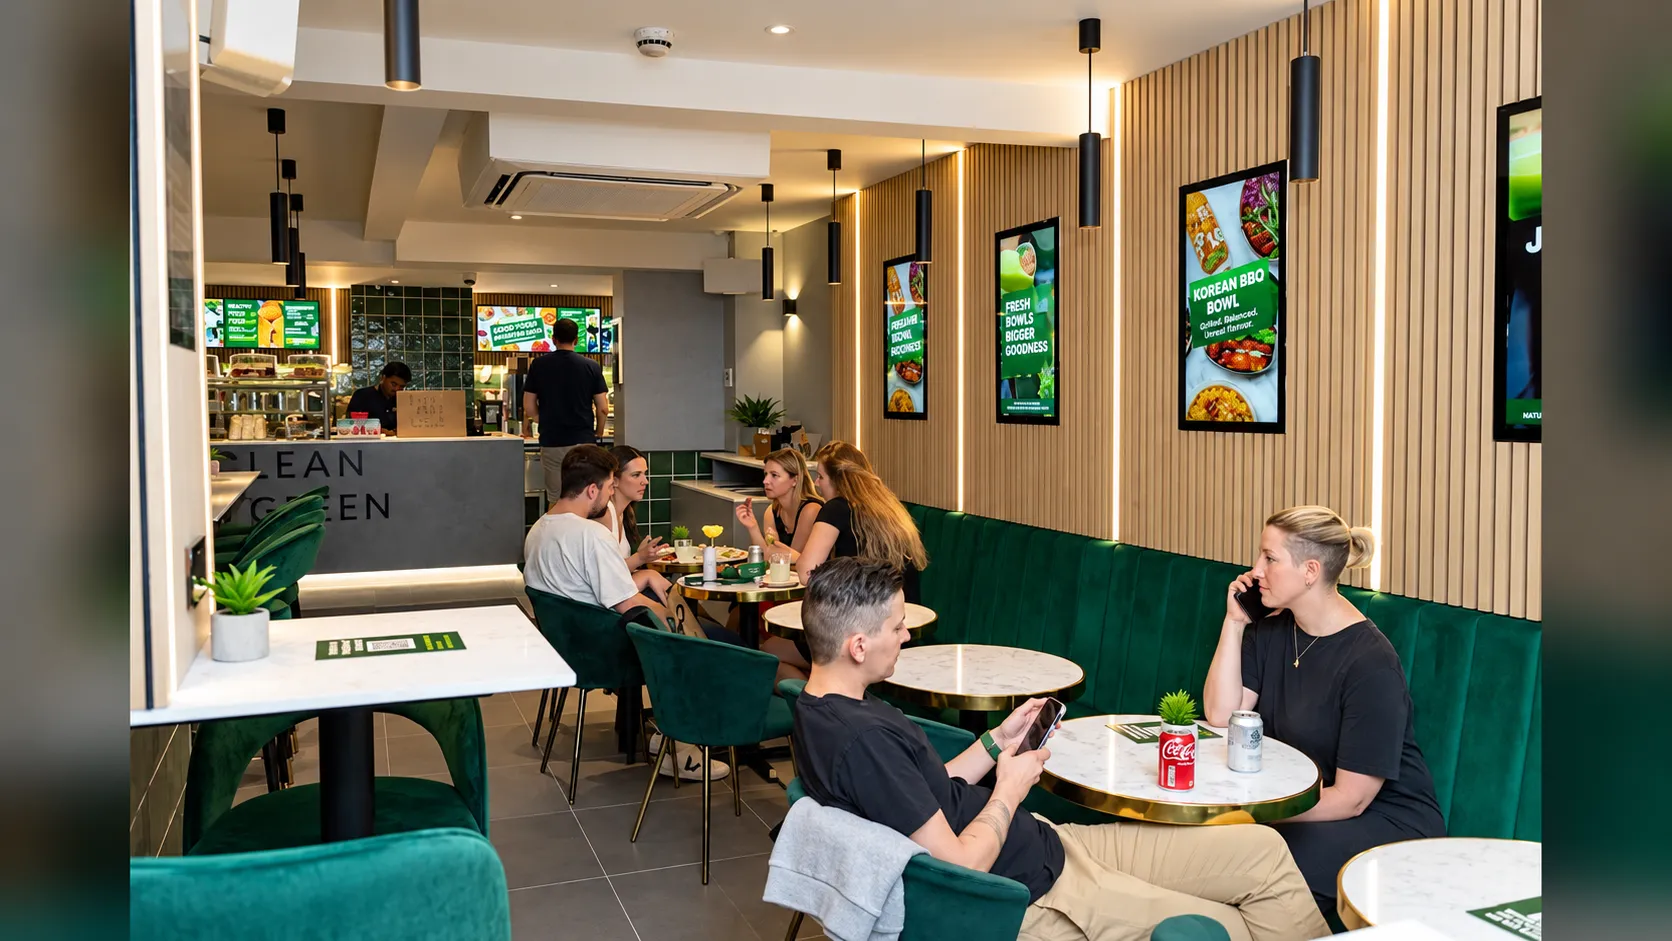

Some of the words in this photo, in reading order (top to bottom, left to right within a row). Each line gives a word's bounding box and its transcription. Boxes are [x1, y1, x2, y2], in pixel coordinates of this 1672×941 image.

[1193, 276, 1238, 302] KOREAN
[1005, 298, 1031, 314] FRESH
[1206, 294, 1240, 315] BOWL
[1005, 312, 1034, 328] BOWLS
[1005, 327, 1035, 342] BIGGER
[1005, 340, 1049, 356] GOODNESS
[250, 493, 390, 523] GEN
